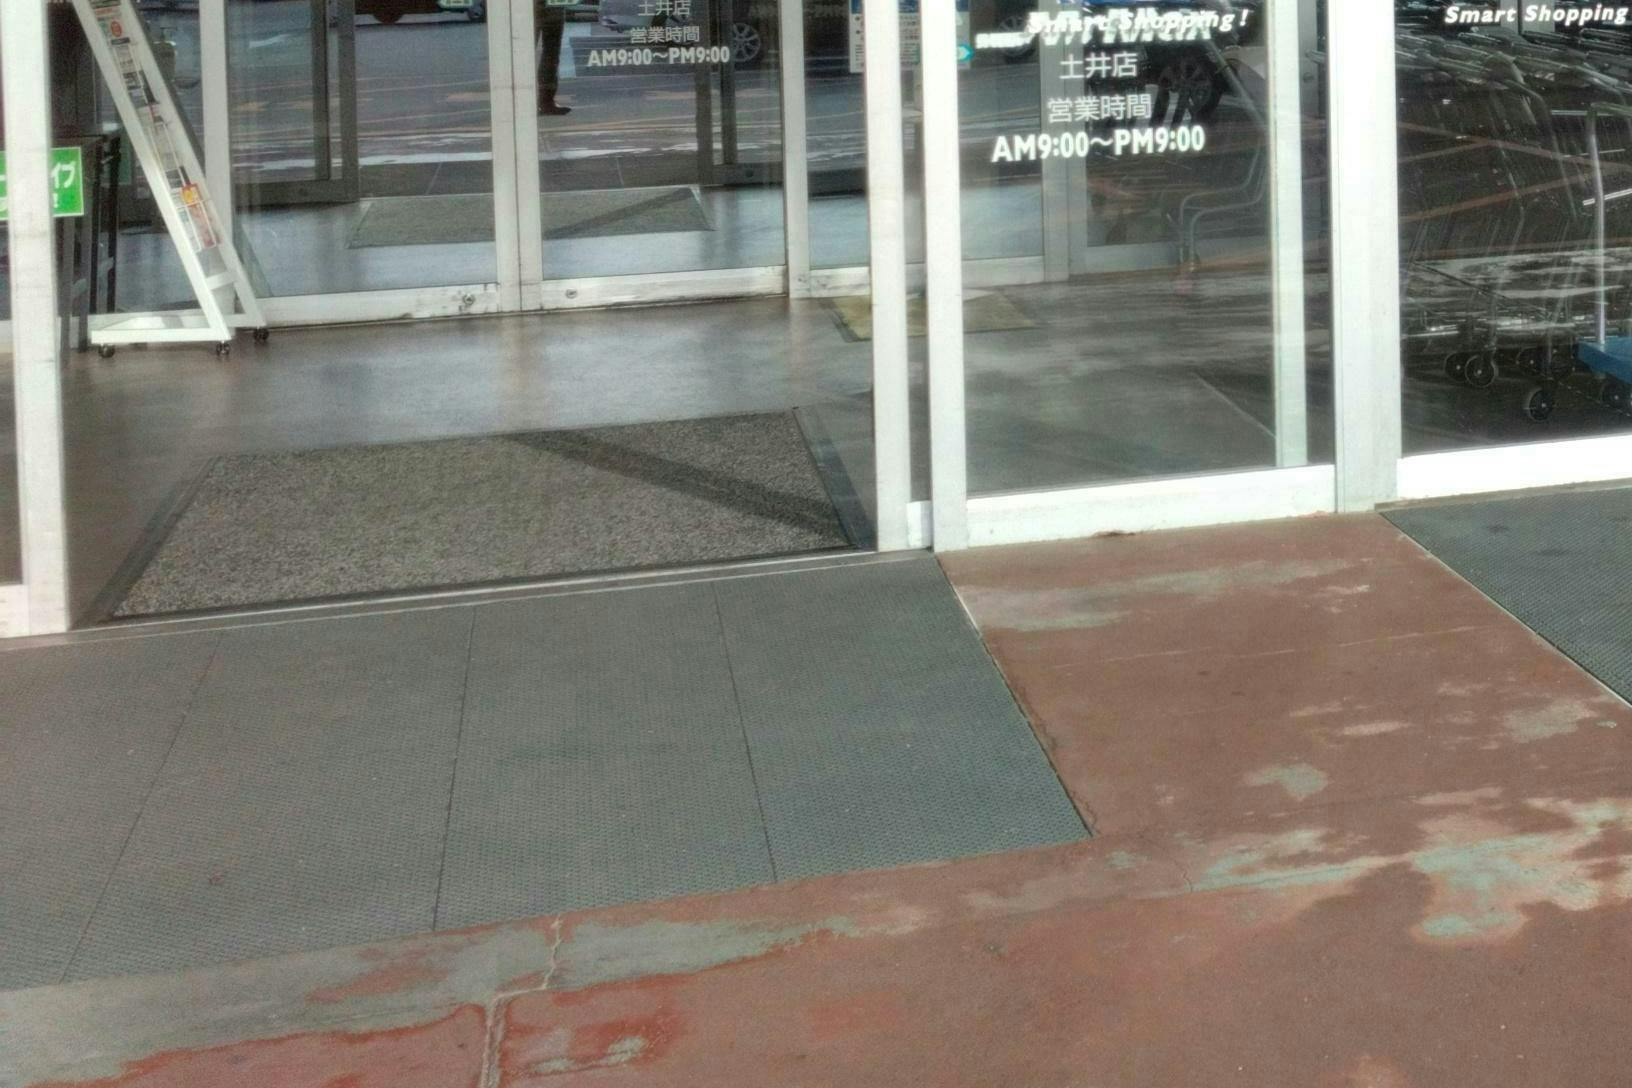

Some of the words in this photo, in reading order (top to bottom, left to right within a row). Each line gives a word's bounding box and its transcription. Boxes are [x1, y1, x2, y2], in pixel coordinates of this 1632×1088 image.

[638, 0, 692, 17] 土井店
[1444, 5, 1517, 24] Smart
[630, 25, 700, 44] 営業時間
[1059, 51, 1138, 80] 土井店
[1048, 93, 1153, 124] 営業時間
